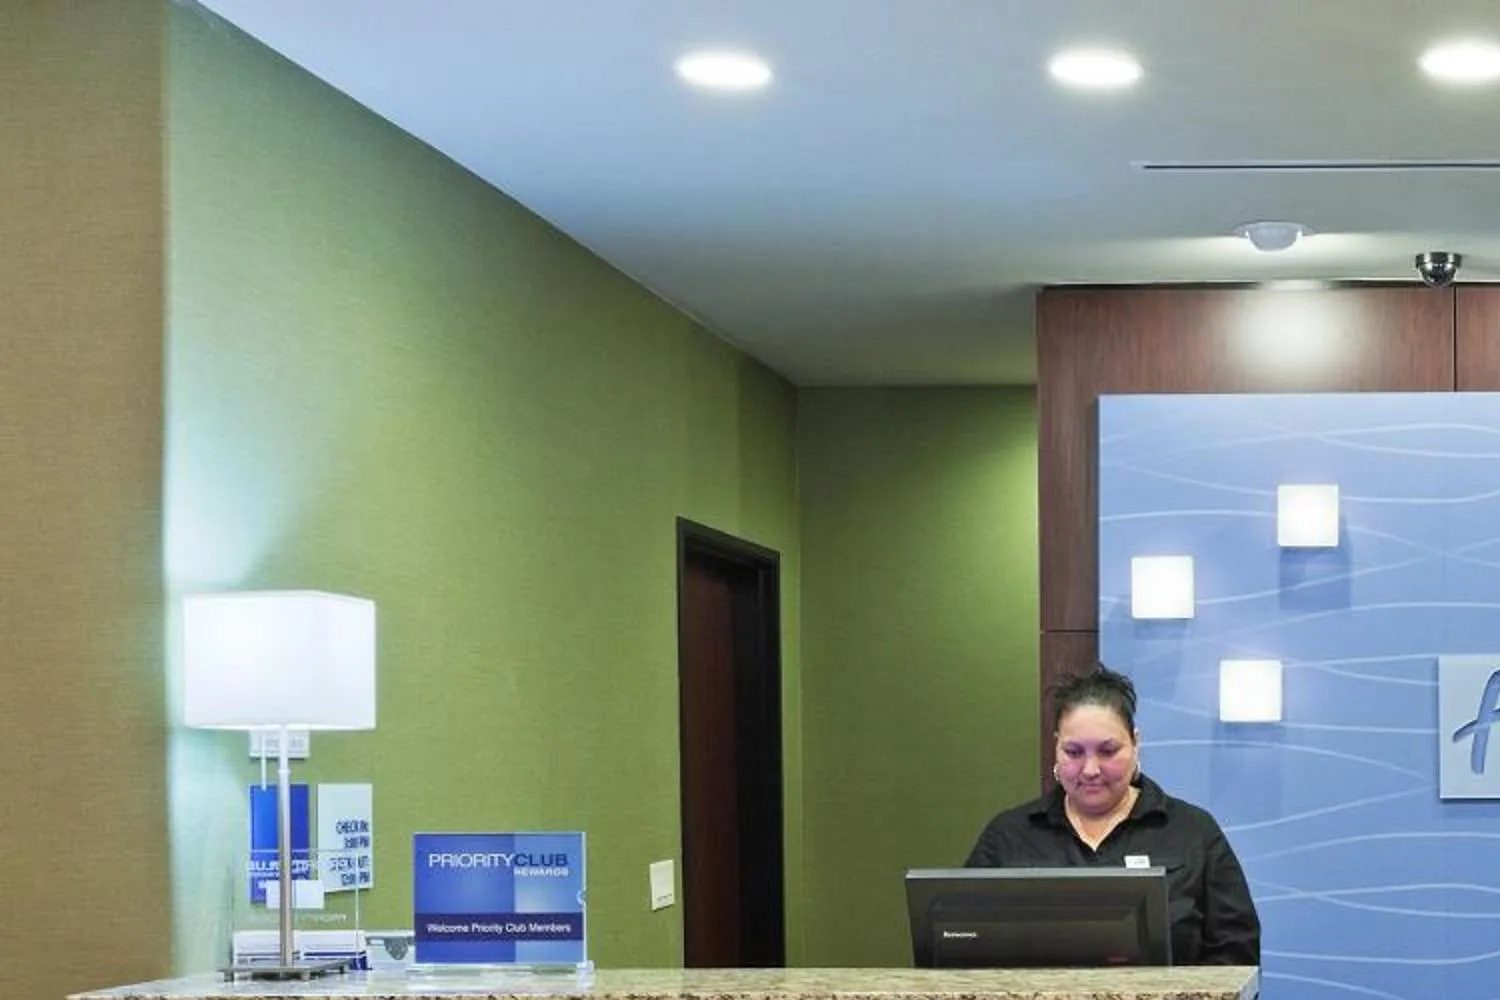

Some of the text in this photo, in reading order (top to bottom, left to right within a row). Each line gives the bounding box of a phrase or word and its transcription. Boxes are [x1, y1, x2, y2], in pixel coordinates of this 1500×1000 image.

[427, 922, 571, 935] Welcome Priority Club Members
